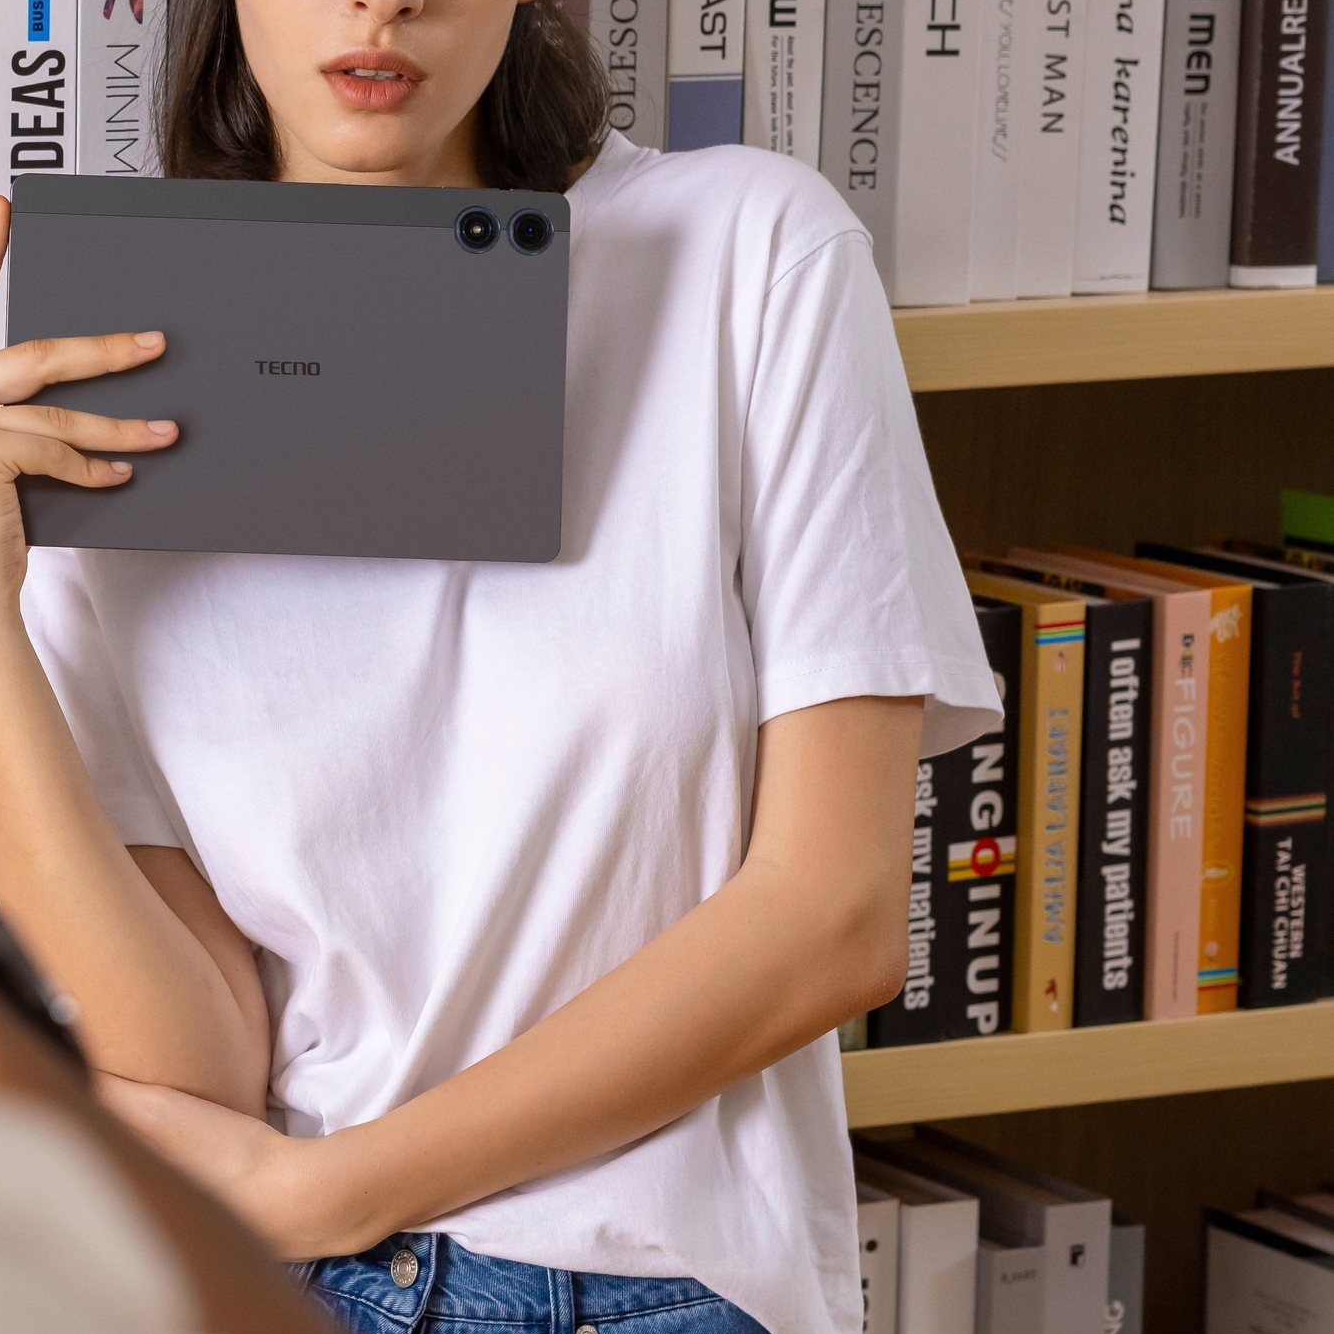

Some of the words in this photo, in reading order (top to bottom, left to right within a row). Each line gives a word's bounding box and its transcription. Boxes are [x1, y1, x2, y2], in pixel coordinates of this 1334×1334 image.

[1185, 14, 1215, 95] men
[11, 50, 65, 169] DEAS
[1041, 54, 1067, 133] MAN
[1109, 58, 1139, 225] karenina
[254, 360, 320, 377] TECNO
[1111, 638, 1141, 652] I
[1109, 657, 1139, 741] often
[1107, 746, 1137, 804] ask
[1101, 809, 1131, 856] my
[1275, 836, 1293, 873] TAI
[1101, 863, 1134, 990] patients
[1273, 877, 1292, 912] CHI
[1288, 864, 1306, 959] WESTERN
[1271, 916, 1291, 990] CHUAN
